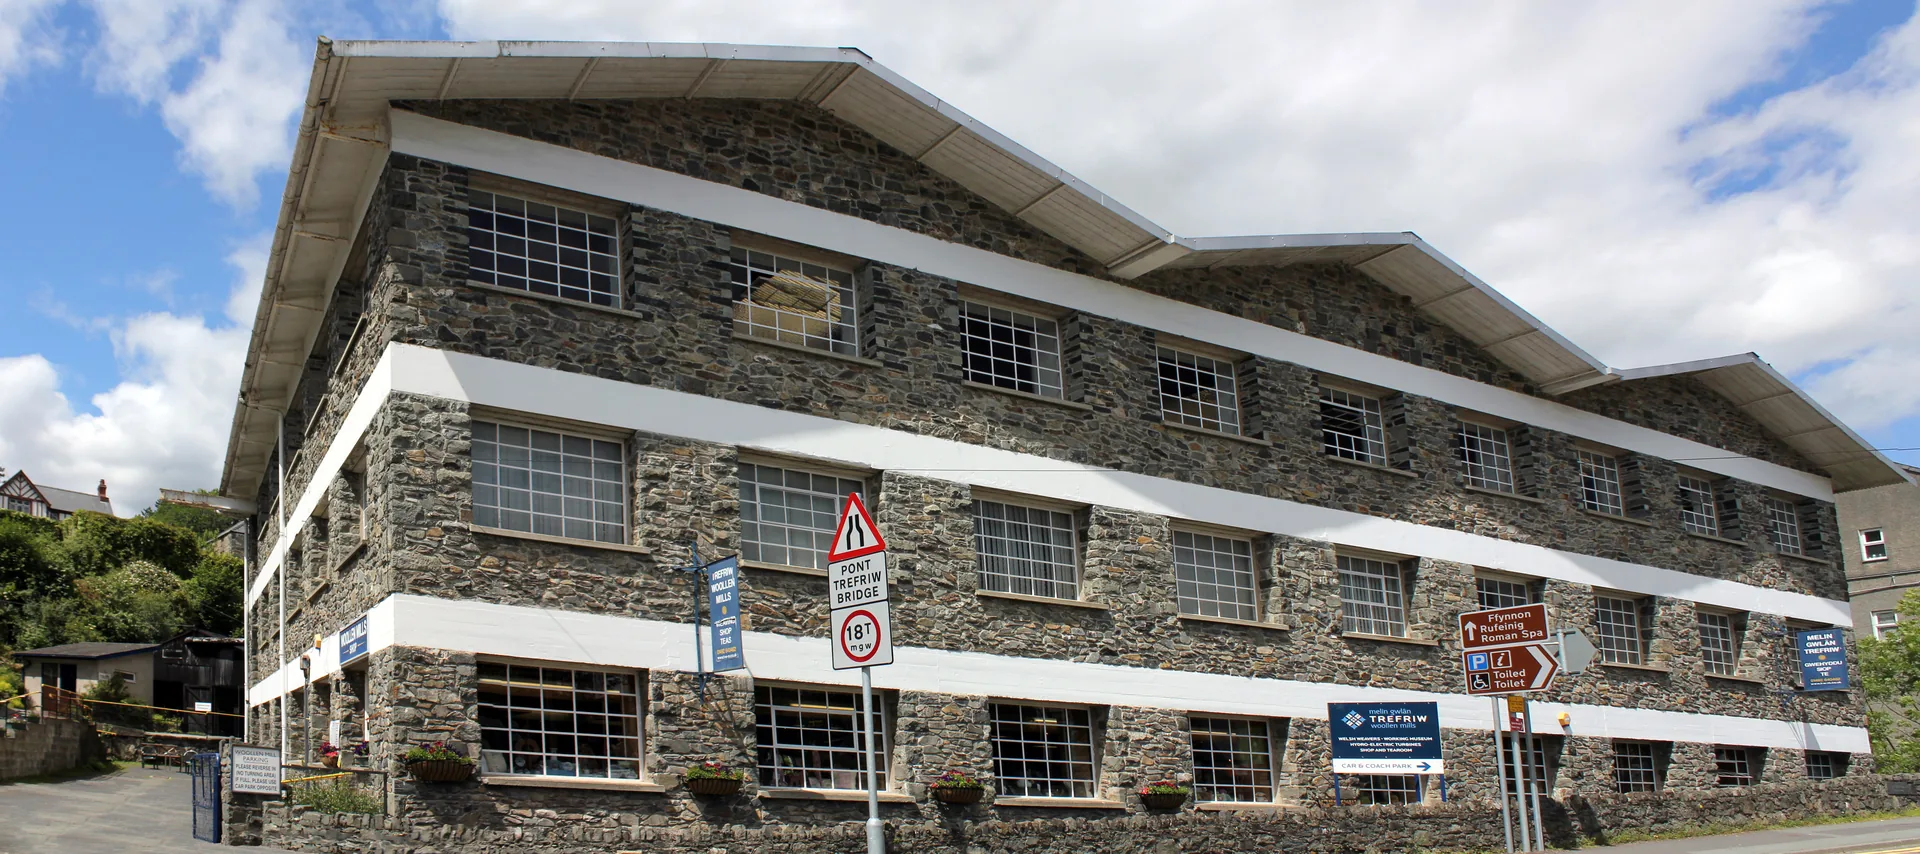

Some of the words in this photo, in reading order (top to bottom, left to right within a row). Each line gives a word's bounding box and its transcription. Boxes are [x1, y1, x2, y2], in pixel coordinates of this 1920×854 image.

[842, 559, 871, 575] PONT
[711, 578, 735, 593] WOOLLEN
[833, 571, 881, 591] TREFRIW
[716, 592, 731, 604] MILLS
[837, 586, 879, 604] BRIDGE
[1488, 611, 1531, 623] Ffynnon
[719, 627, 732, 636] SHOP
[847, 622, 871, 641] 18T
[1480, 622, 1524, 633] Rufeinig
[720, 636, 732, 645] TEAS
[1481, 633, 1518, 643] Roman
[1521, 629, 1543, 639] Spa
[1807, 633, 1833, 641] MELIN
[1472, 654, 1485, 670] P
[1493, 668, 1526, 679] Toiled
[1494, 679, 1525, 689] Toilet
